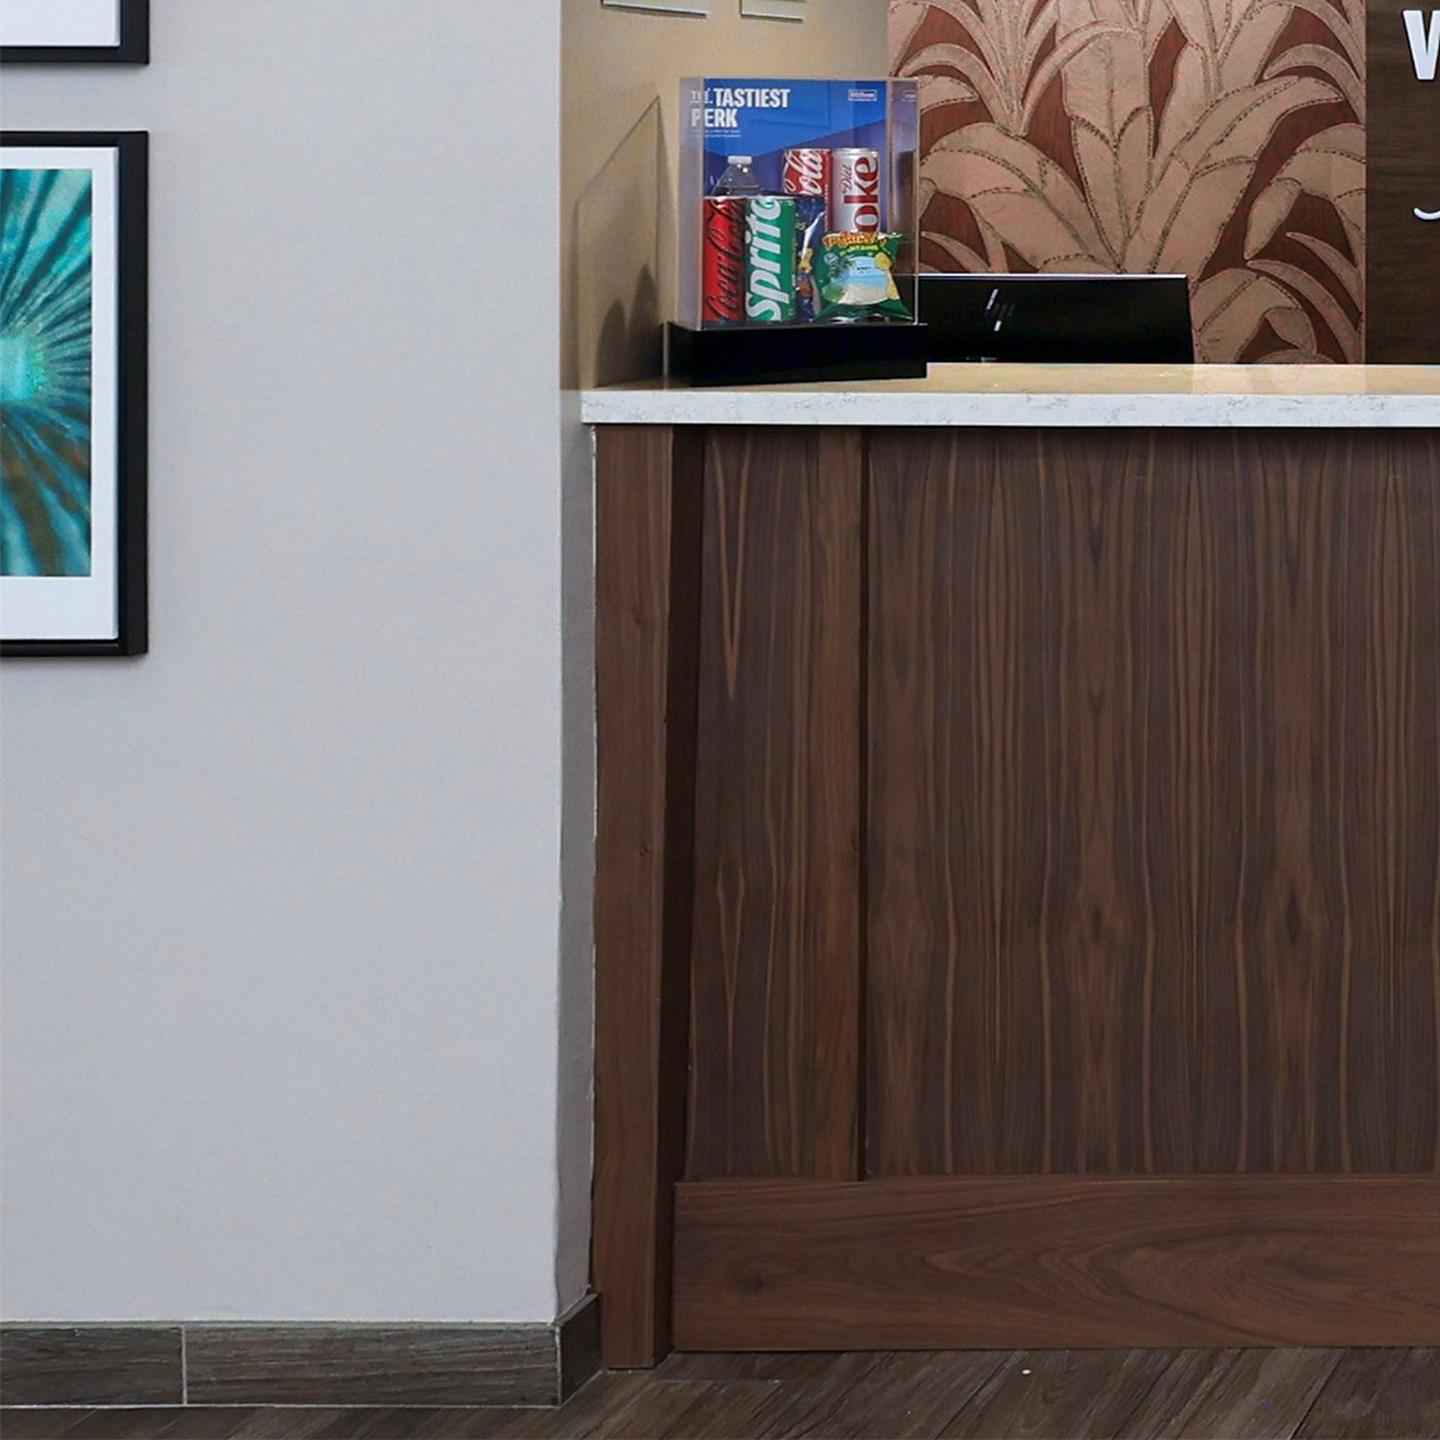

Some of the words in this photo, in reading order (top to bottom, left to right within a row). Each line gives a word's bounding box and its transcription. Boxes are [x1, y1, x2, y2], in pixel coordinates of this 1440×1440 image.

[691, 108, 739, 128] PERK
[713, 88, 791, 108] TASTIEST
[843, 156, 880, 232] oke
[745, 197, 790, 321] Sprite
